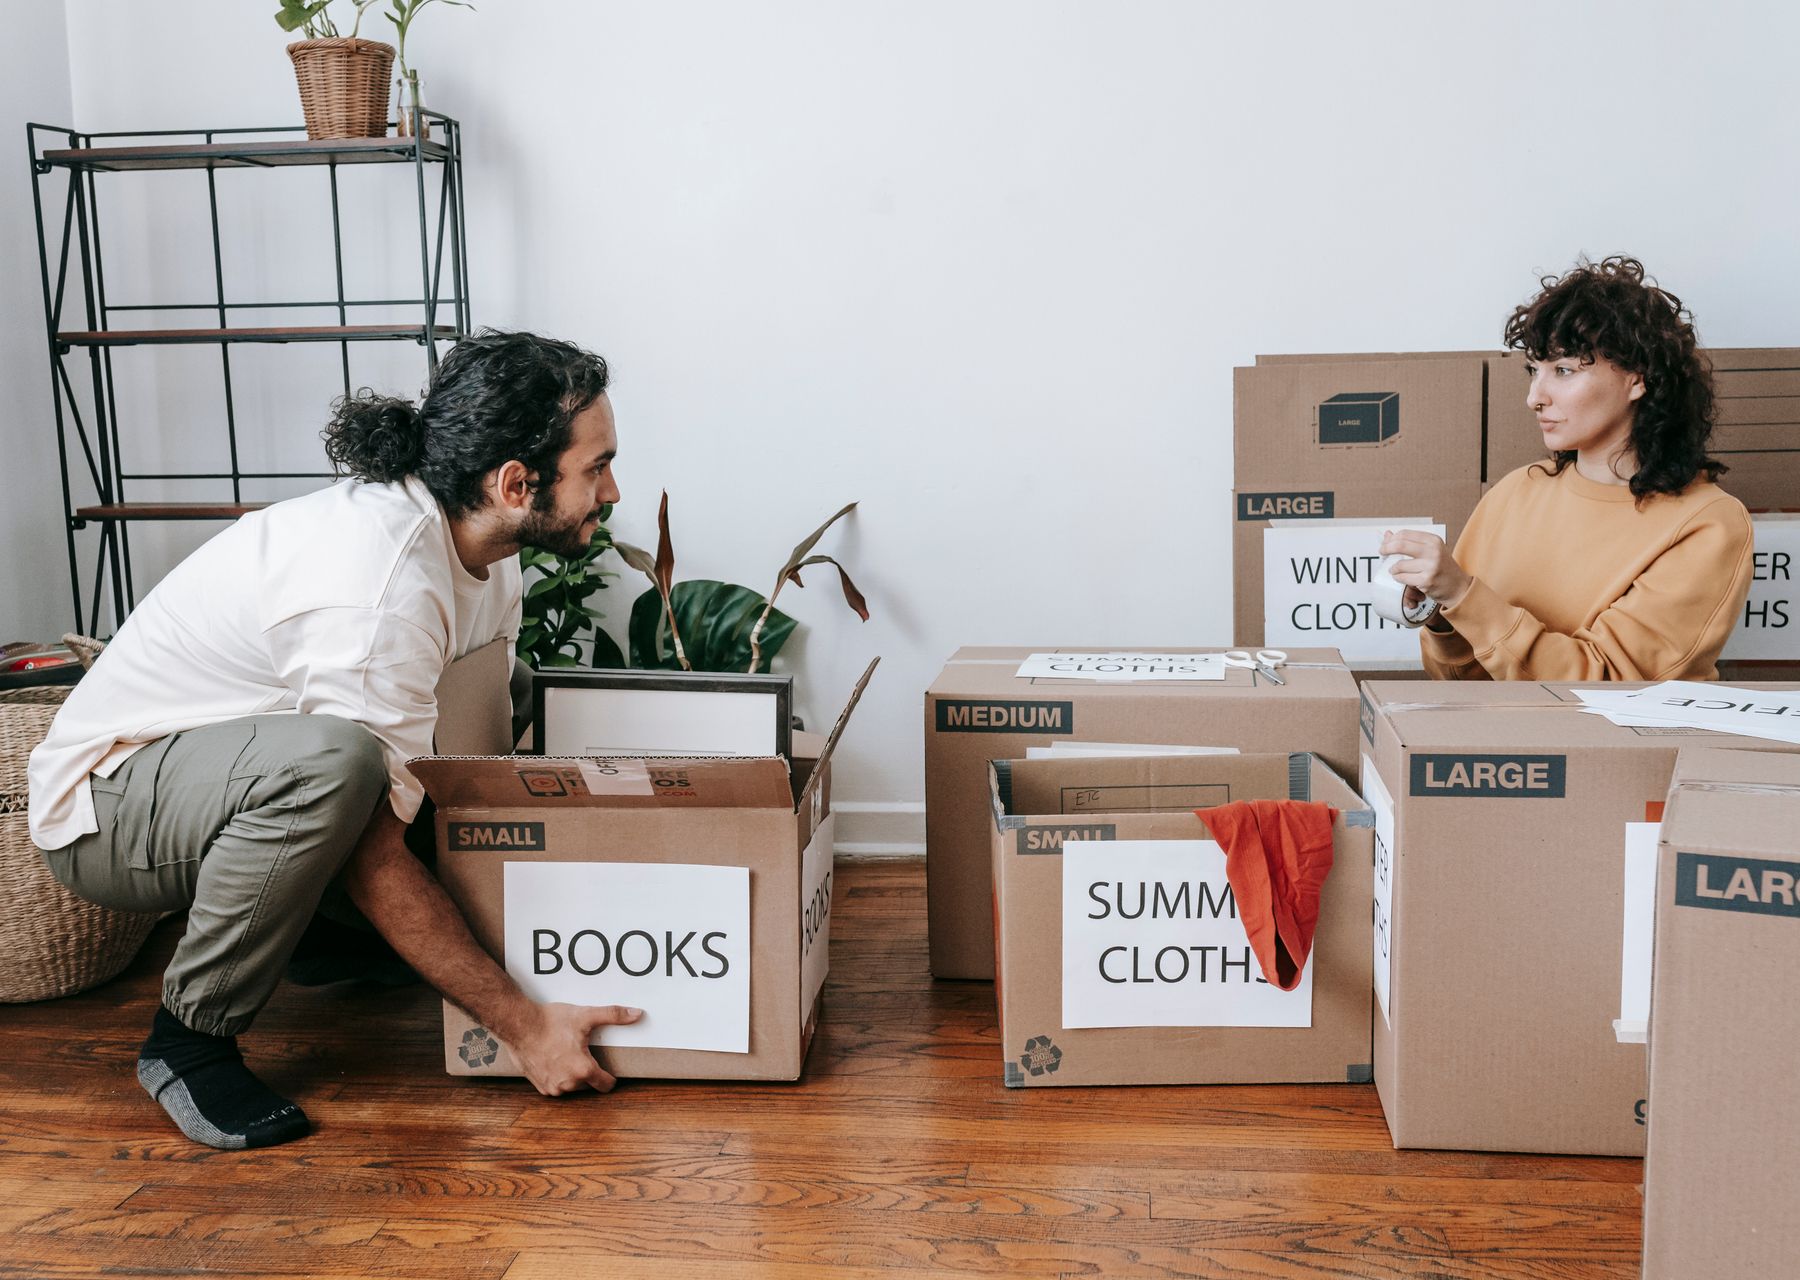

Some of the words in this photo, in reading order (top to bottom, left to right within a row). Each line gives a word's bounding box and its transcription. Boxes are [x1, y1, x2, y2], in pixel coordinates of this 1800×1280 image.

[1246, 497, 1324, 516] LARGE
[1290, 556, 1380, 584] WINT
[1291, 603, 1400, 630] CLOT
[1050, 664, 1198, 673] CLOTHS
[946, 706, 1062, 728] MEDIUM
[1661, 697, 1800, 717] FICE
[655, 779, 691, 787] OS
[1425, 762, 1549, 789] LARGE
[1074, 790, 1101, 806] ETC
[457, 827, 537, 846] SMALL
[1376, 833, 1389, 893] TER
[1696, 864, 1800, 906] LAR
[1087, 881, 1237, 919] SUMM
[805, 871, 831, 957] BOOKS
[1374, 897, 1388, 959] THS
[532, 929, 730, 979] BOOKS
[1098, 945, 1268, 984] CLOTH
